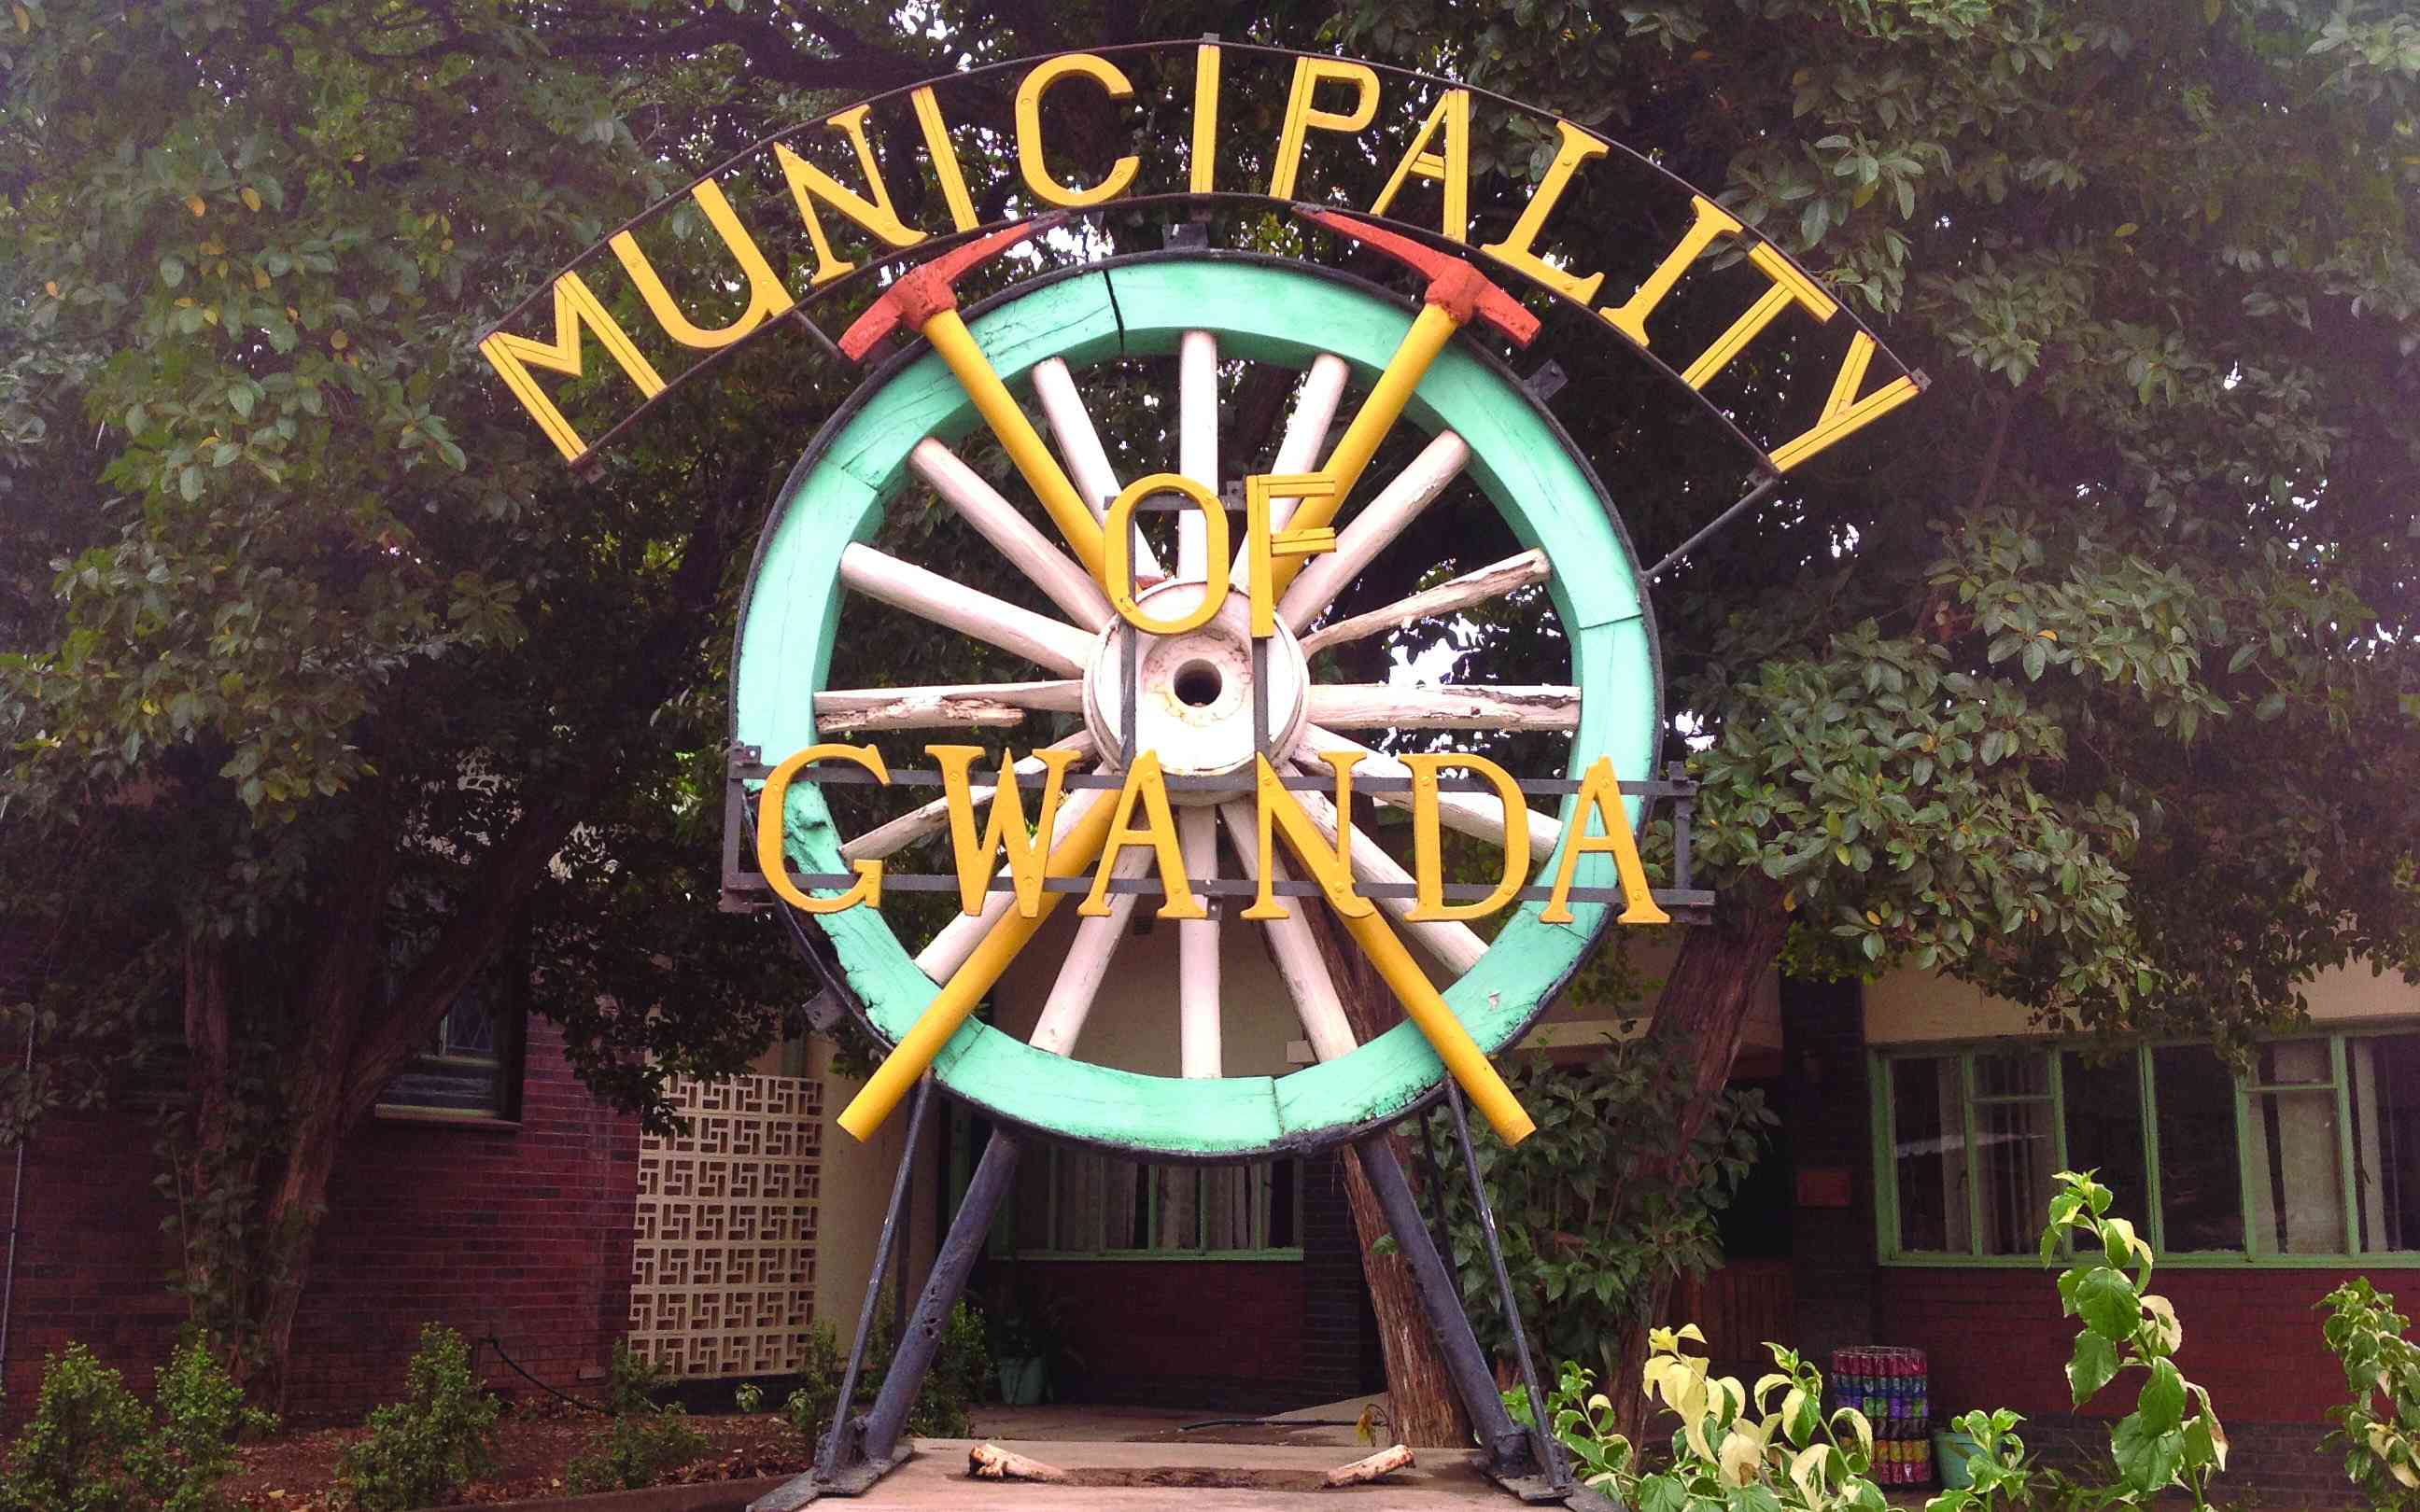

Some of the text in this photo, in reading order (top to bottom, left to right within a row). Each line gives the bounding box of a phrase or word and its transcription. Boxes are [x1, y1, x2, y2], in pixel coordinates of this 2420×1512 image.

[479, 44, 1920, 472] MUNICIPALITY
[1104, 471, 1336, 637] OF
[757, 743, 1671, 925] GWANDA
